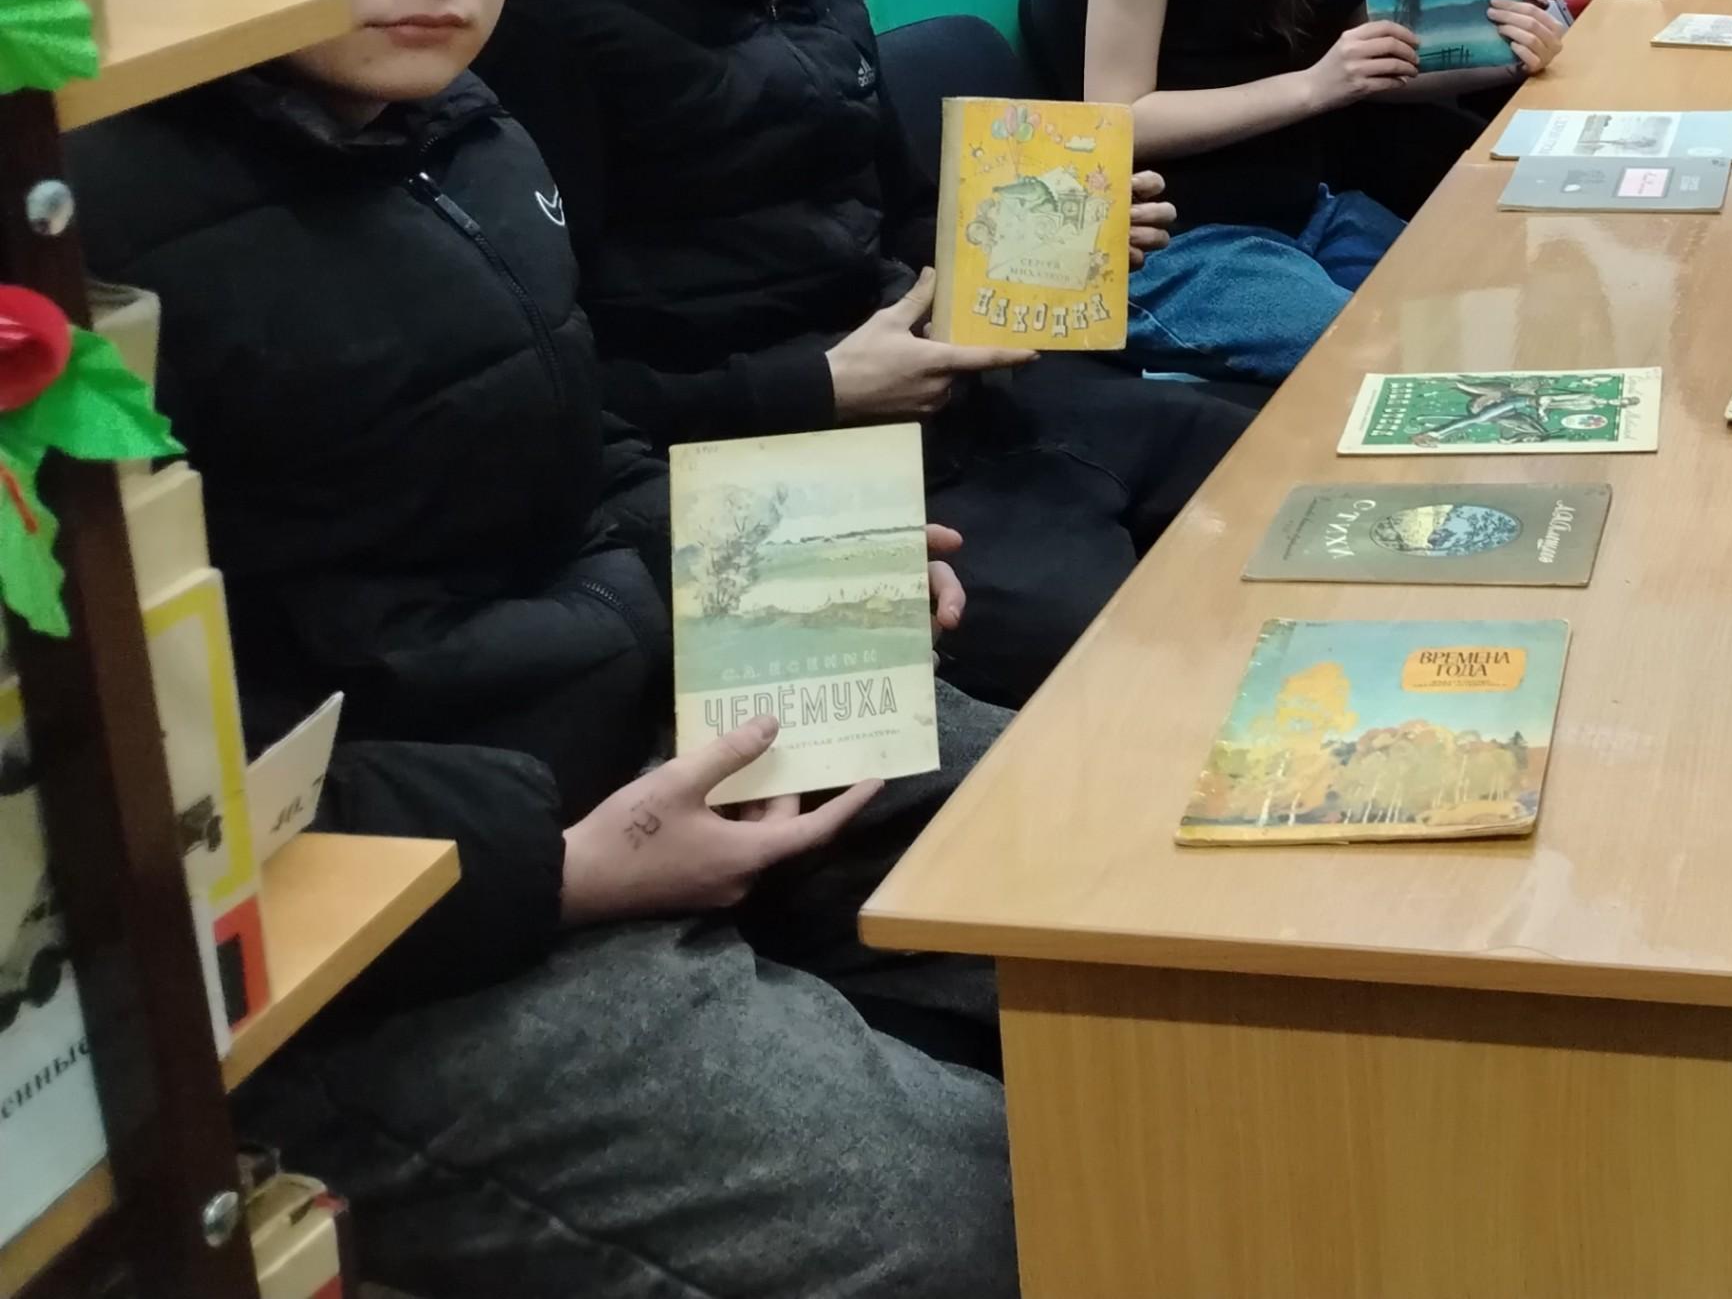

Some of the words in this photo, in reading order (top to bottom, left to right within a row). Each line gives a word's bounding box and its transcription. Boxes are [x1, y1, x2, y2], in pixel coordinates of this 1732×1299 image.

[972, 287, 1112, 339] НАХОДКА
[1323, 498, 1378, 561] СТИХИ
[769, 648, 879, 677] ЕСЕНИН
[1419, 651, 1511, 665] ВРЕМЕНА
[1436, 663, 1488, 677] ГОДА
[704, 675, 898, 737] ЧЕРЁМУХА
